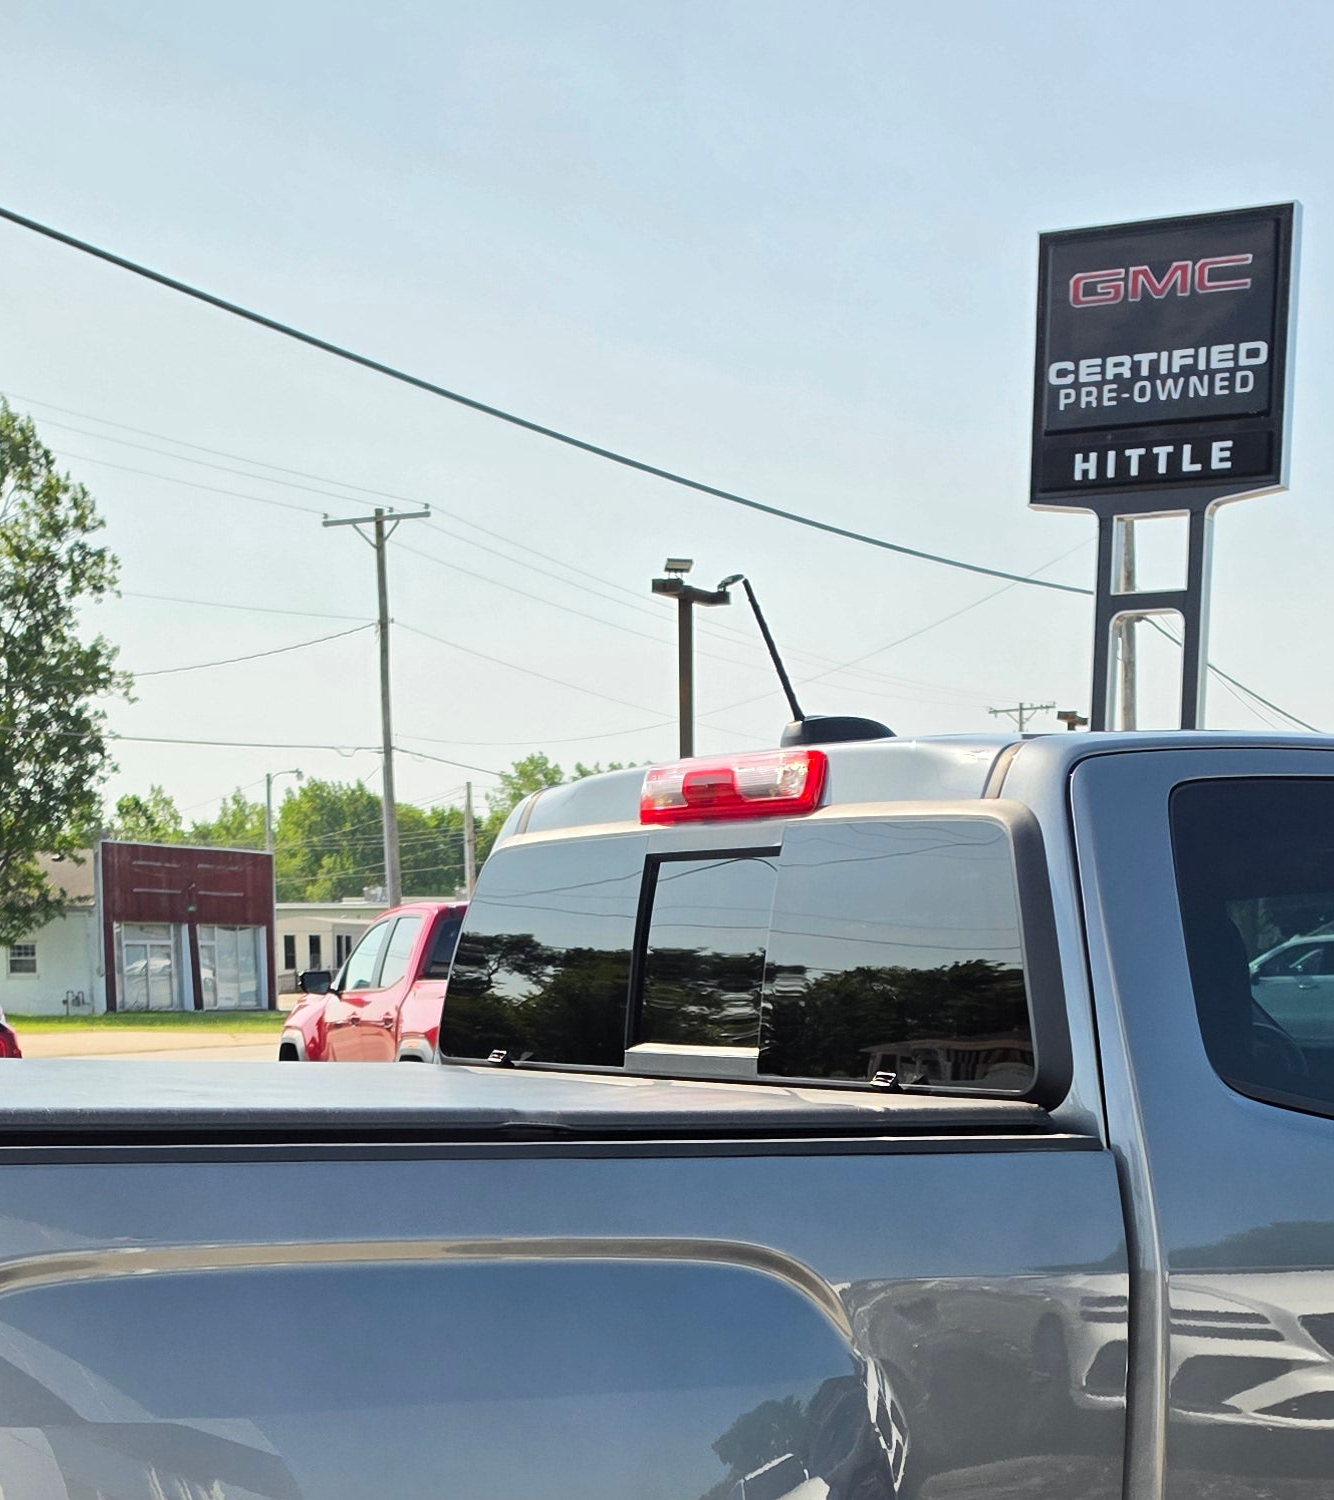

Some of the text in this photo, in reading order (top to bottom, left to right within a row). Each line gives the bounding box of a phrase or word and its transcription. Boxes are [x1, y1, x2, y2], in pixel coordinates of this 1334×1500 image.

[1069, 253, 1252, 307] GMC
[1048, 341, 1268, 385] CERTIFIED
[1059, 370, 1254, 411] PRE-OWNED
[1073, 440, 1234, 482] HITTLE
